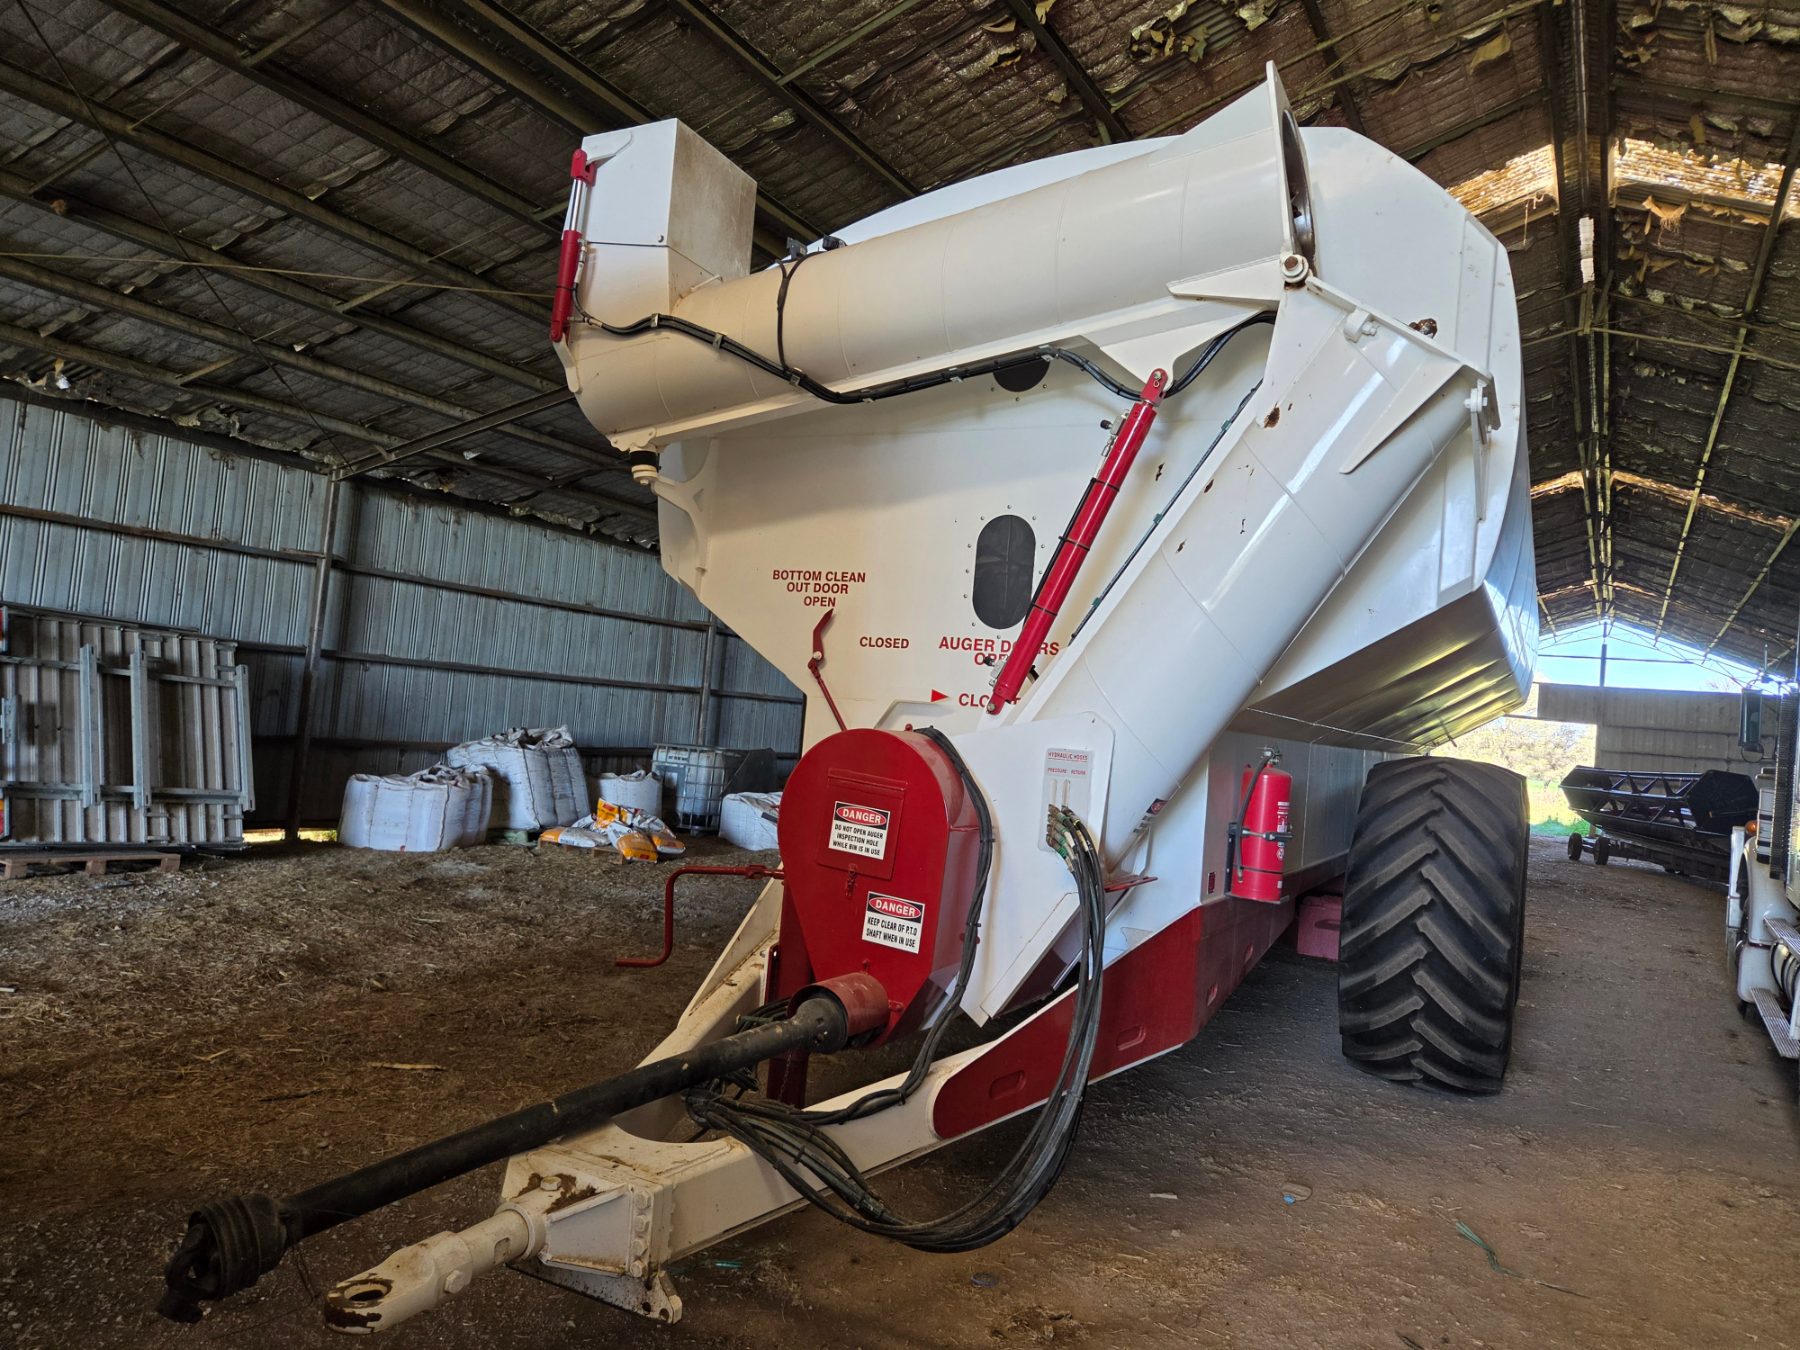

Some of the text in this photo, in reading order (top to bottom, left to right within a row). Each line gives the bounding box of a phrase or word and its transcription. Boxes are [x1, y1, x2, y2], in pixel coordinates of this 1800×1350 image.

[773, 570, 866, 583] BOTTOM CLEAN
[787, 582, 849, 594] OUT DOOR
[803, 596, 836, 607] OPEN
[859, 636, 910, 649] CLOSED
[939, 636, 1060, 656] AUGER DRS
[842, 808, 882, 824] DANGER
[836, 832, 879, 847] INSPECTION HOLE
[843, 825, 853, 833] NOT
[853, 827, 867, 836] OPEN
[867, 830, 884, 840] AUGER
[833, 840, 848, 849] WHILE
[849, 843, 858, 851] BIN
[875, 899, 916, 917] DANGER
[868, 916, 880, 926] KEEP
[880, 920, 897, 931] CLEAR
[898, 923, 906, 933] OF
[866, 928, 916, 948] SHAFT WHEN IN USE
